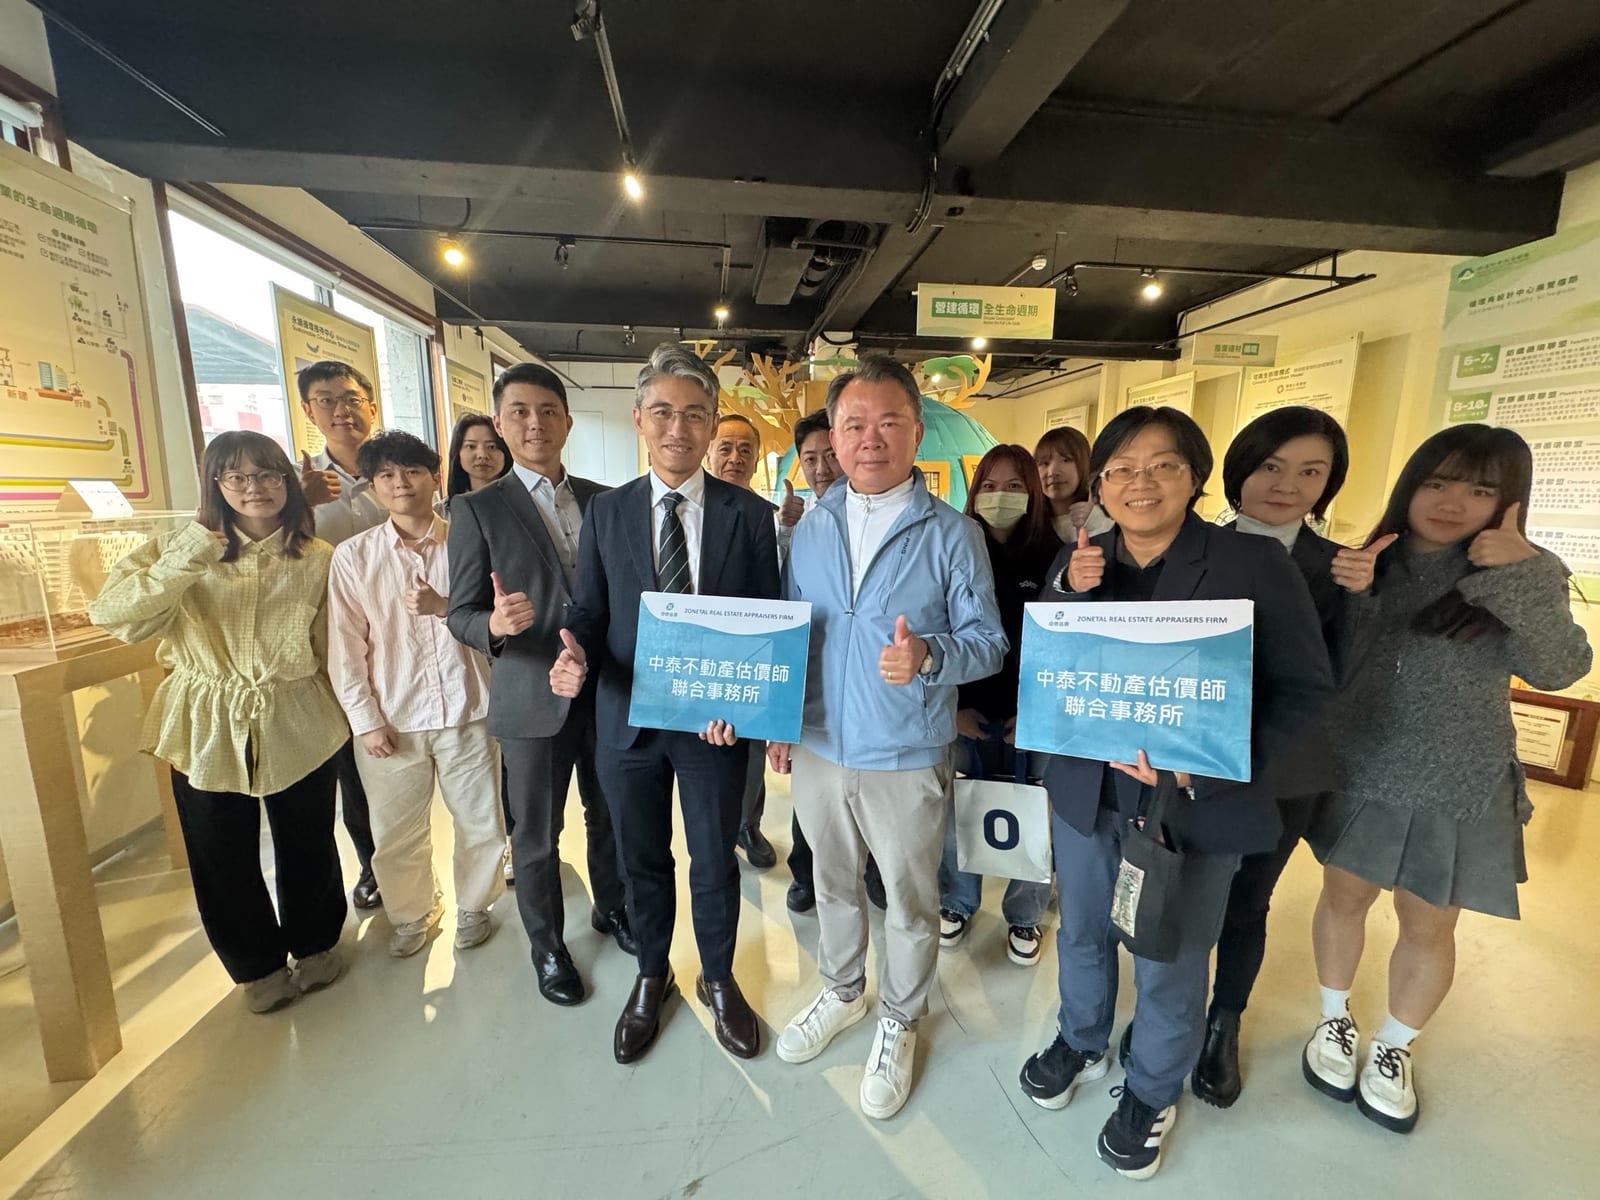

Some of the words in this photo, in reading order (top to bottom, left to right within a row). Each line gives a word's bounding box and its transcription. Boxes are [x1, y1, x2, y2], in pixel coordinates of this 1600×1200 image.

[935, 301, 980, 316] 營建循環
[983, 303, 1039, 317] 全生命週期
[684, 607, 709, 616] ZONETAL
[709, 609, 723, 617] REAL
[723, 610, 743, 618] ESTATE
[743, 611, 778, 620] APPRAISERS
[778, 613, 794, 621] FIRM
[1076, 615, 1107, 623] ZONETAL
[1108, 615, 1127, 623] REAL
[1155, 616, 1204, 624] APPRAISERS
[1205, 616, 1228, 624] FIRM
[649, 654, 790, 683] 中泰不動產估價師
[671, 678, 760, 704] 聯合事務所
[1036, 668, 1227, 703] 中泰不動產估價師
[1064, 695, 1184, 727] 聯合事務所
